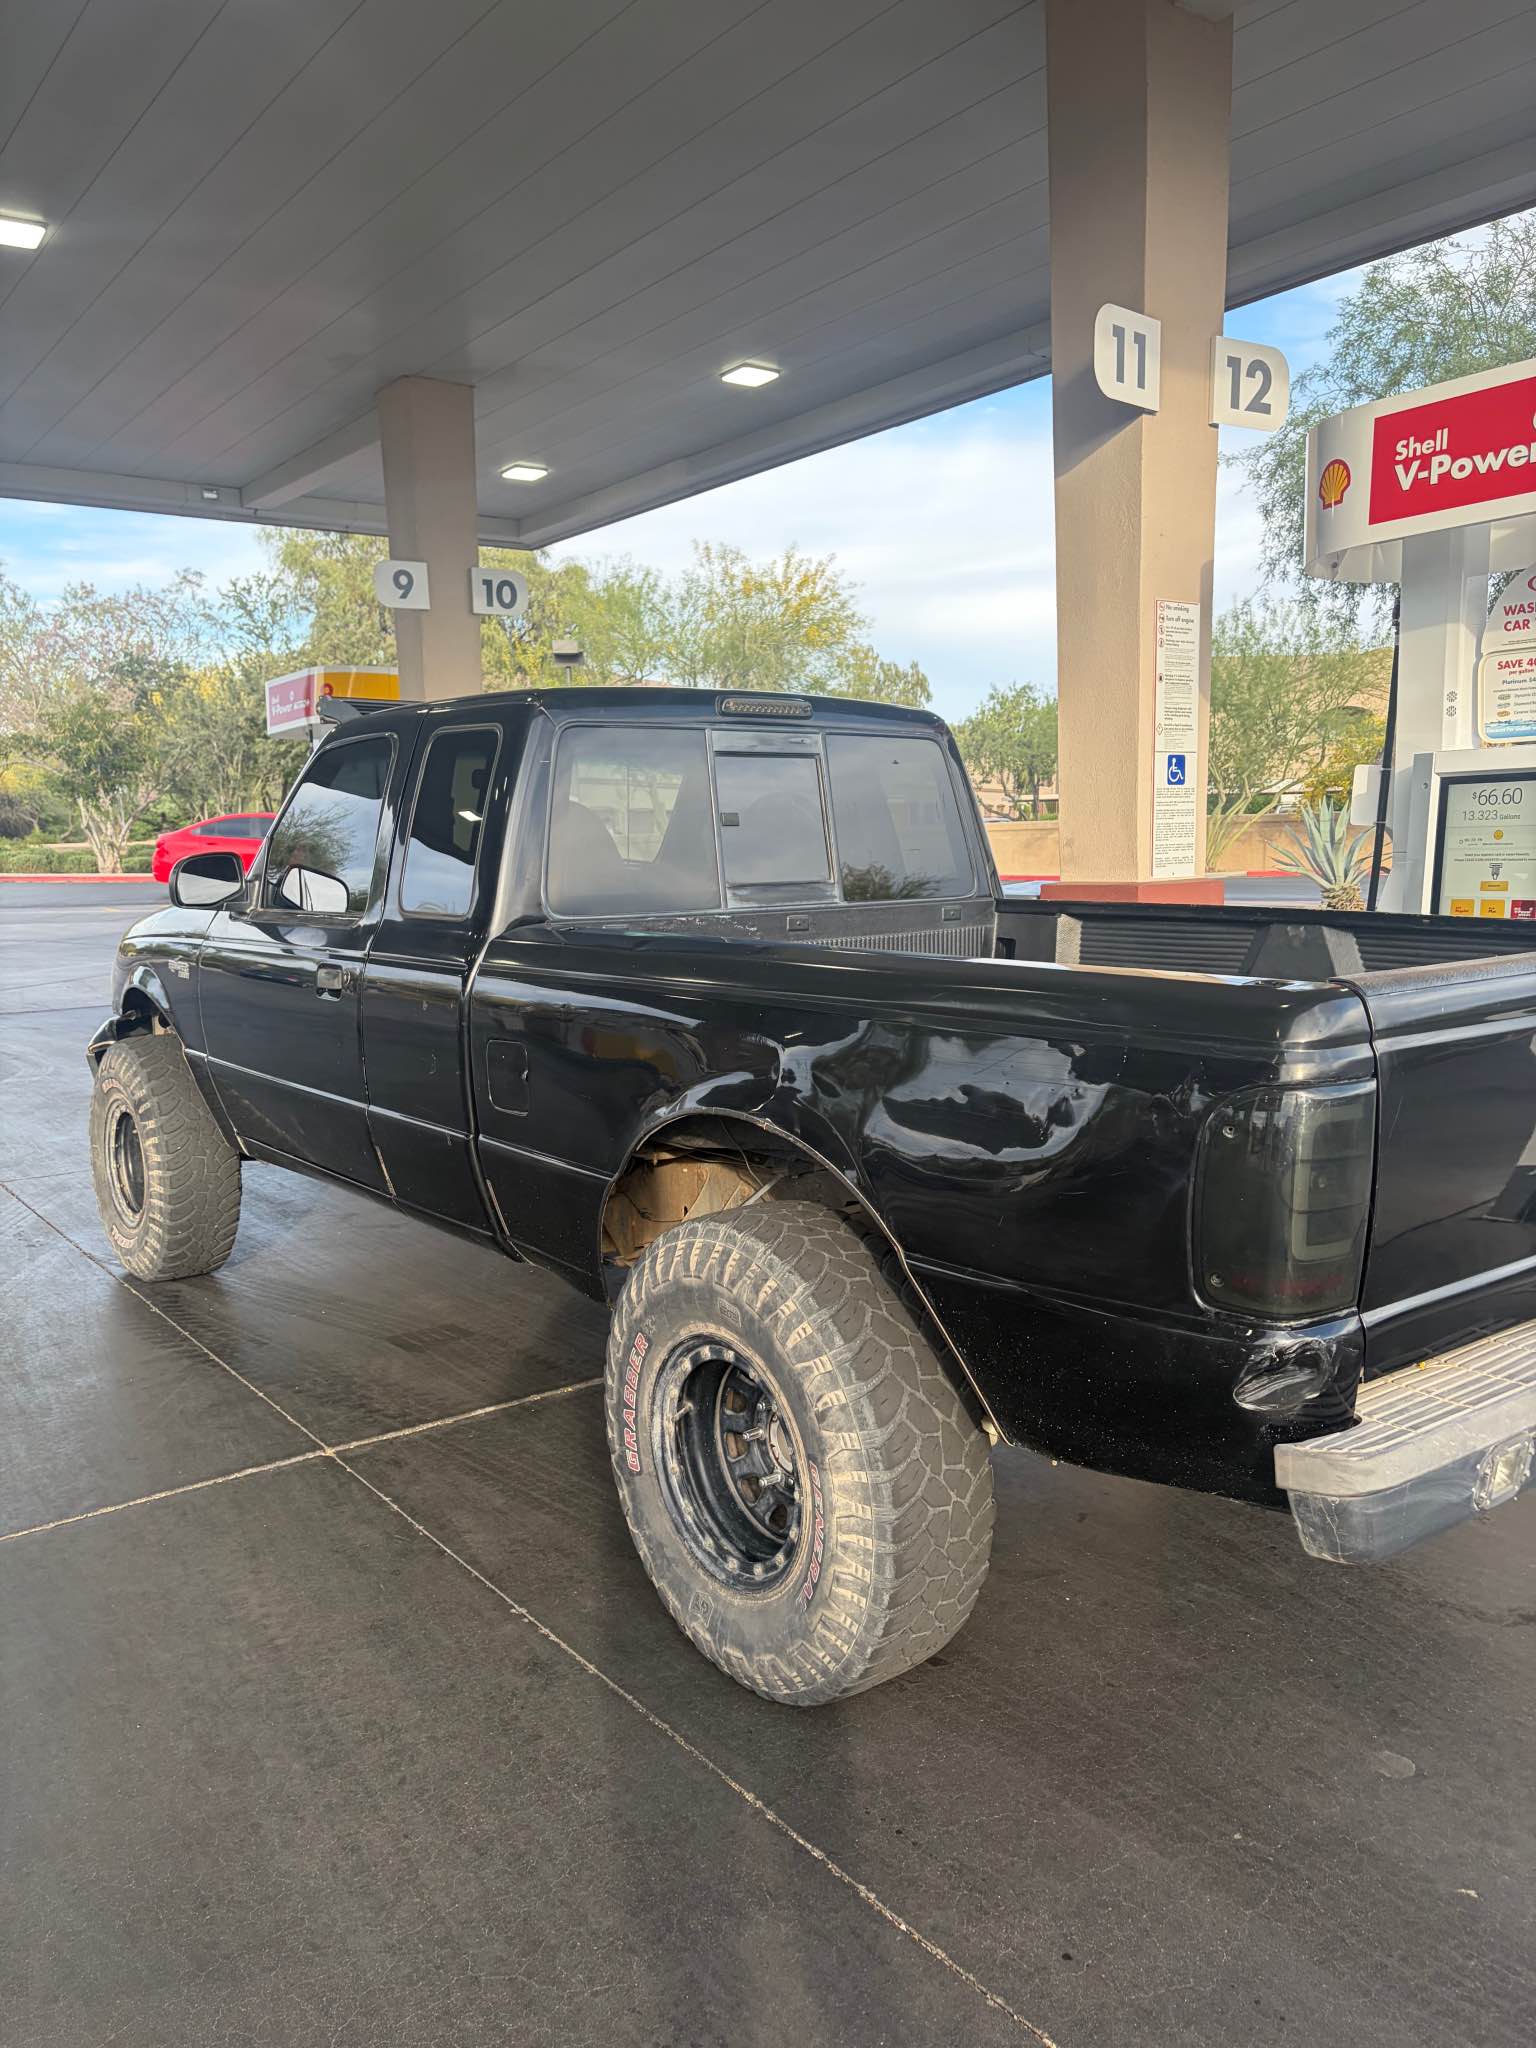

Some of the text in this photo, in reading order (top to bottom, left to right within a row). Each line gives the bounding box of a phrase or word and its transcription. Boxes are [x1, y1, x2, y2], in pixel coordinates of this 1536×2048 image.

[1112, 323, 1146, 390] 11
[1227, 355, 1272, 415] 12
[1395, 427, 1449, 461] Shell
[392, 569, 414, 599] 9
[482, 578, 518, 610] 10
[1503, 602, 1536, 616] WAS
[1503, 618, 1531, 632] CAR
[1497, 659, 1524, 671] SAVE
[1472, 787, 1523, 806] $66.60
[1462, 809, 1498, 821] 13.323
[624, 1332, 648, 1472] GRABBER
